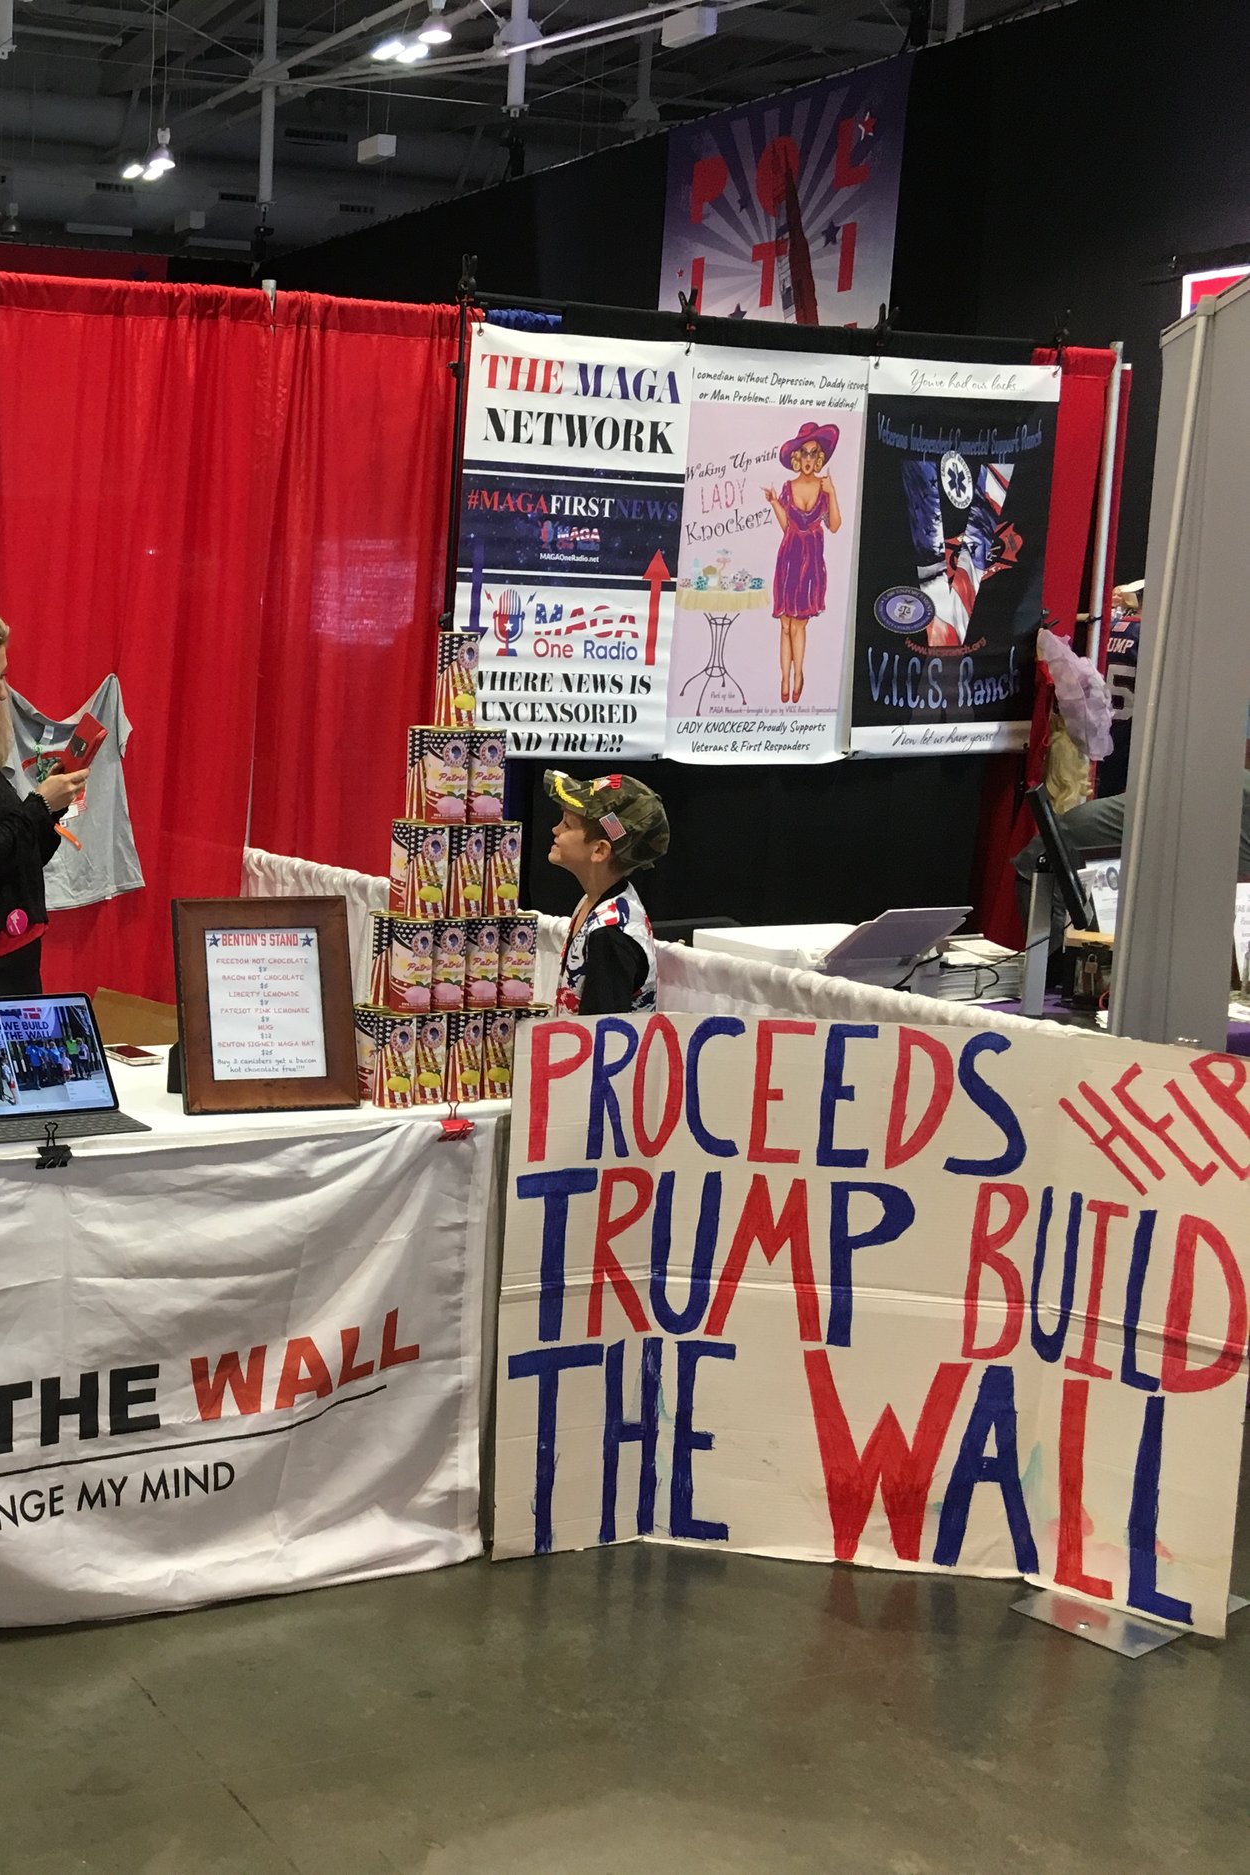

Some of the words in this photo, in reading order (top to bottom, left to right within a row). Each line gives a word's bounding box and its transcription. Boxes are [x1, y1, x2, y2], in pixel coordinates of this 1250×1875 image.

[481, 354, 564, 394] THE
[573, 363, 681, 404] MAGA
[697, 370, 735, 382] comedian
[737, 372, 769, 384] without
[819, 376, 845, 392] Daddy
[948, 371, 973, 390] had
[699, 392, 708, 400] or
[710, 389, 730, 401] Man
[779, 394, 797, 405] Who
[800, 398, 813, 406] are
[816, 399, 825, 407] we
[827, 397, 858, 412] kidding!
[482, 407, 675, 454] NETWORK
[685, 463, 726, 482] Waking
[729, 451, 752, 473] Up
[755, 446, 779, 464] with
[467, 489, 678, 521] #MAGAFIRSTNEWS
[701, 478, 747, 514] LADY
[685, 508, 773, 545] Knockerz
[540, 552, 599, 563] MAGAOneRadio.net
[534, 603, 639, 638] MAGA
[533, 638, 573, 659] One
[584, 640, 638, 660] Radio
[1107, 637, 1134, 654] UMP
[559, 673, 623, 694] NEWS
[629, 675, 651, 695] IS
[867, 647, 947, 709] V.I.C.S.
[958, 645, 1020, 707] Ranch
[481, 702, 637, 724] UNCENSORED
[676, 721, 702, 735] LADY
[704, 720, 755, 734] KNOCKERZ
[757, 721, 788, 736] Proudly
[790, 720, 826, 735] Supports
[945, 726, 967, 744] have
[548, 733, 624, 753] TRUE!!
[691, 740, 728, 753] Veterans
[730, 741, 739, 752] &
[741, 740, 762, 752] First
[764, 739, 810, 753] Responders
[221, 933, 267, 946] BENTON'S
[269, 933, 299, 946] STAND
[4, 1021, 21, 1032] WE
[22, 1020, 49, 1031] BUILD
[4, 1031, 23, 1040] THE
[24, 1030, 52, 1041] WALL
[526, 1013, 1027, 1176] PROCEEDS
[1058, 1052, 1250, 1196] HELP
[516, 1167, 915, 1348] TRUMP
[961, 1183, 1249, 1394] BUILD
[189, 1307, 421, 1422] WALL
[76, 1475, 130, 1512] MY
[140, 1461, 236, 1500] MIND
[507, 1337, 736, 1554] THE
[804, 1350, 1193, 1625] WALL
